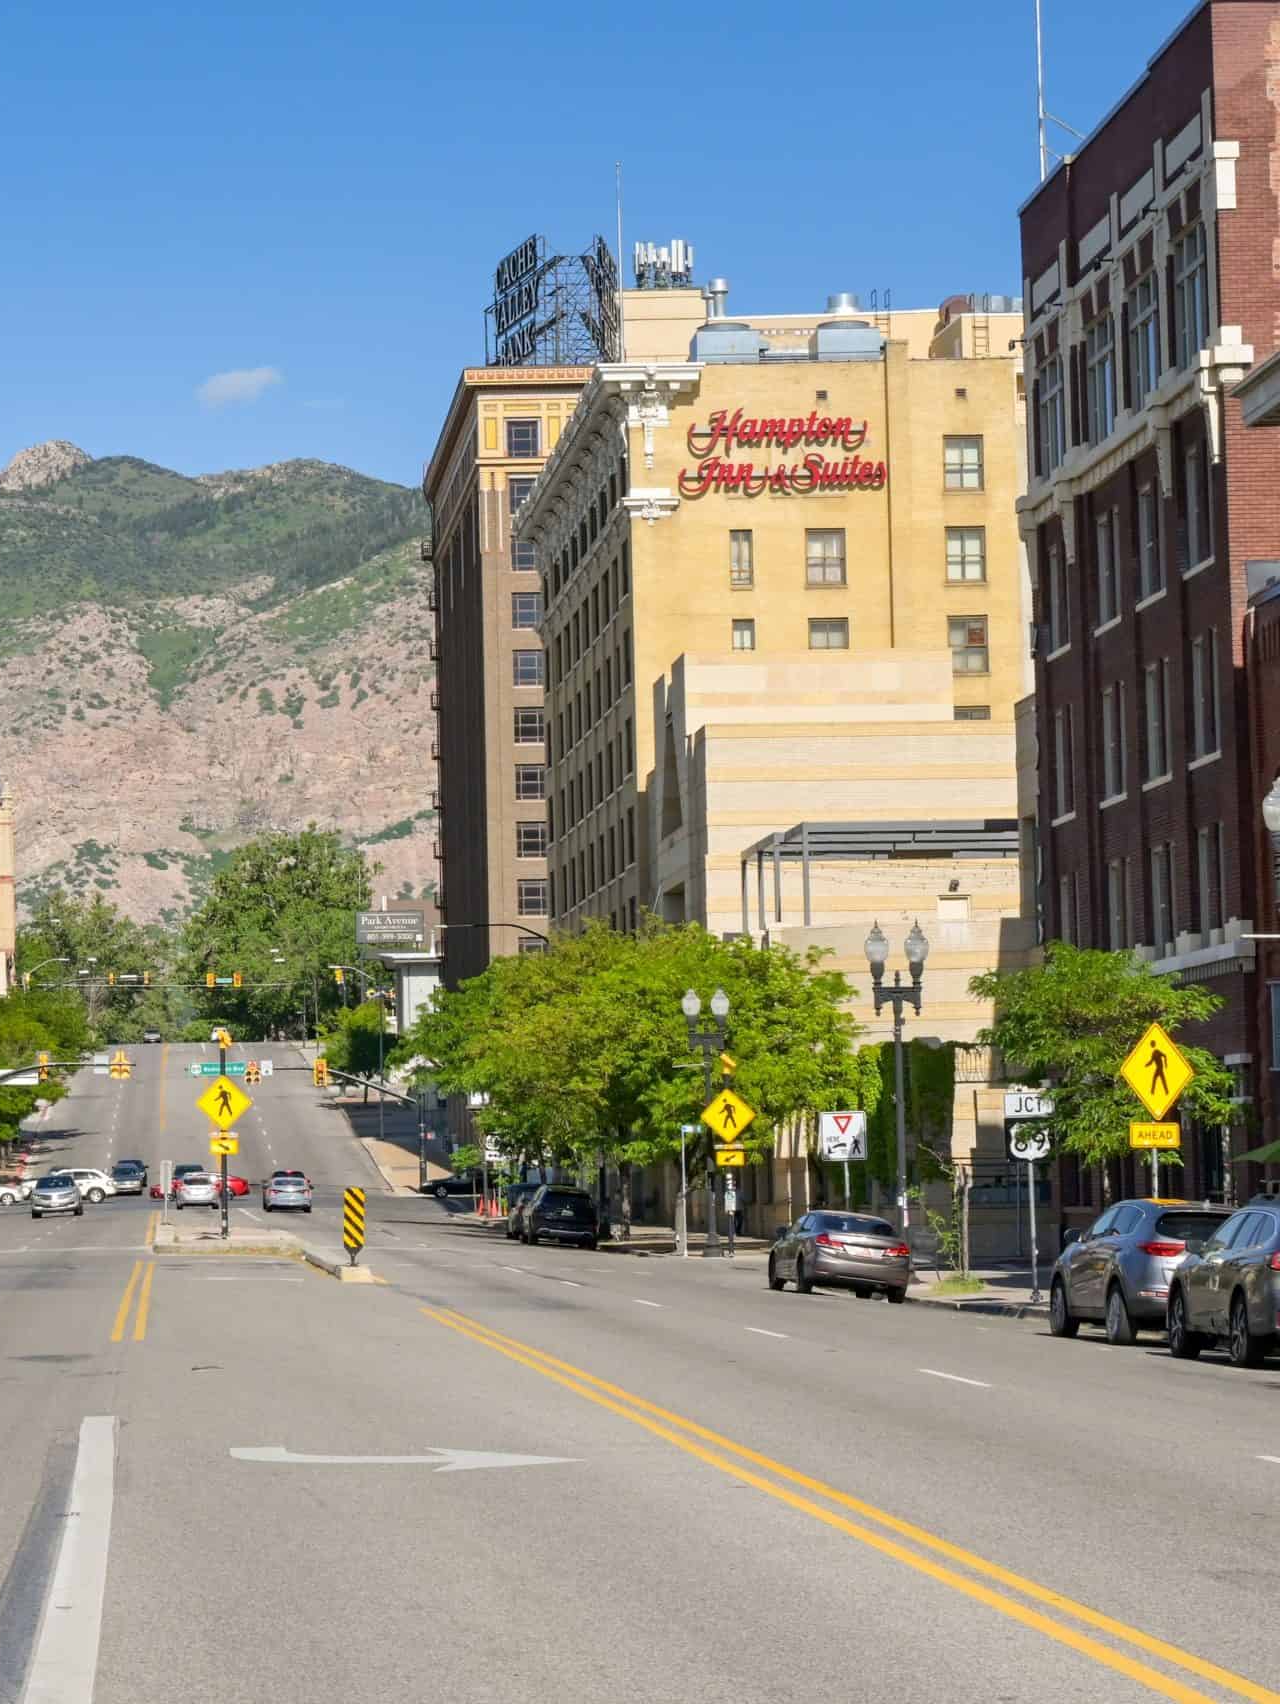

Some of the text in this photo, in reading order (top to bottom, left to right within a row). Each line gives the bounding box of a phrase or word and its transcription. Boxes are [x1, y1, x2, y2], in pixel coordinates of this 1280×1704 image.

[496, 235, 537, 294] CACHE
[495, 273, 540, 337] VALLEY
[501, 320, 535, 367] BANK
[688, 407, 867, 454] Hampton
[679, 453, 887, 494] Inn & Suites
[361, 916, 419, 925] Park Avenue
[1014, 1096, 1042, 1113] JCT
[1137, 1130, 1174, 1141] AHEAD
